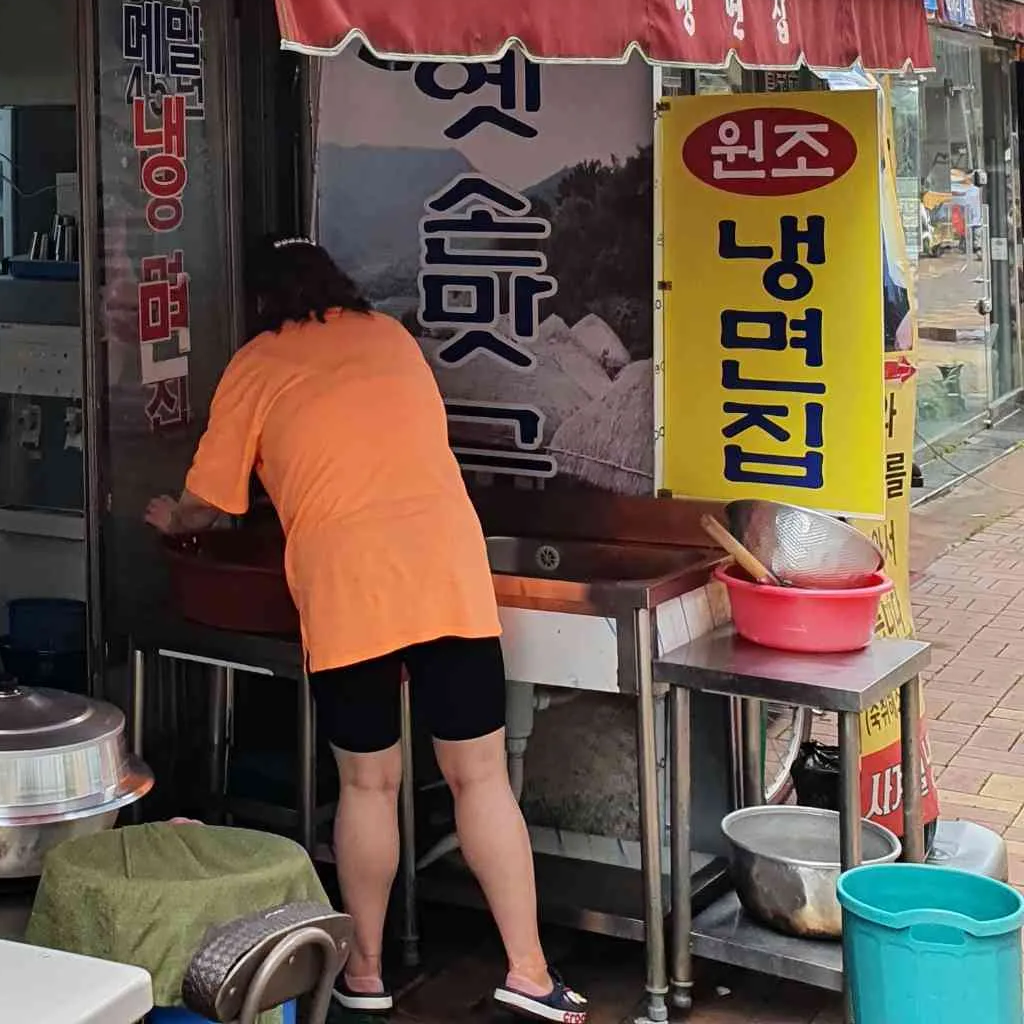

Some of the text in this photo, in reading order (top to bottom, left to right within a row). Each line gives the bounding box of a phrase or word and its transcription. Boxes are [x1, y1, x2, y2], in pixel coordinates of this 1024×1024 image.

[710, 118, 836, 181] 원조
[420, 174, 558, 370] 손맛
[718, 214, 827, 492] 냉면집
